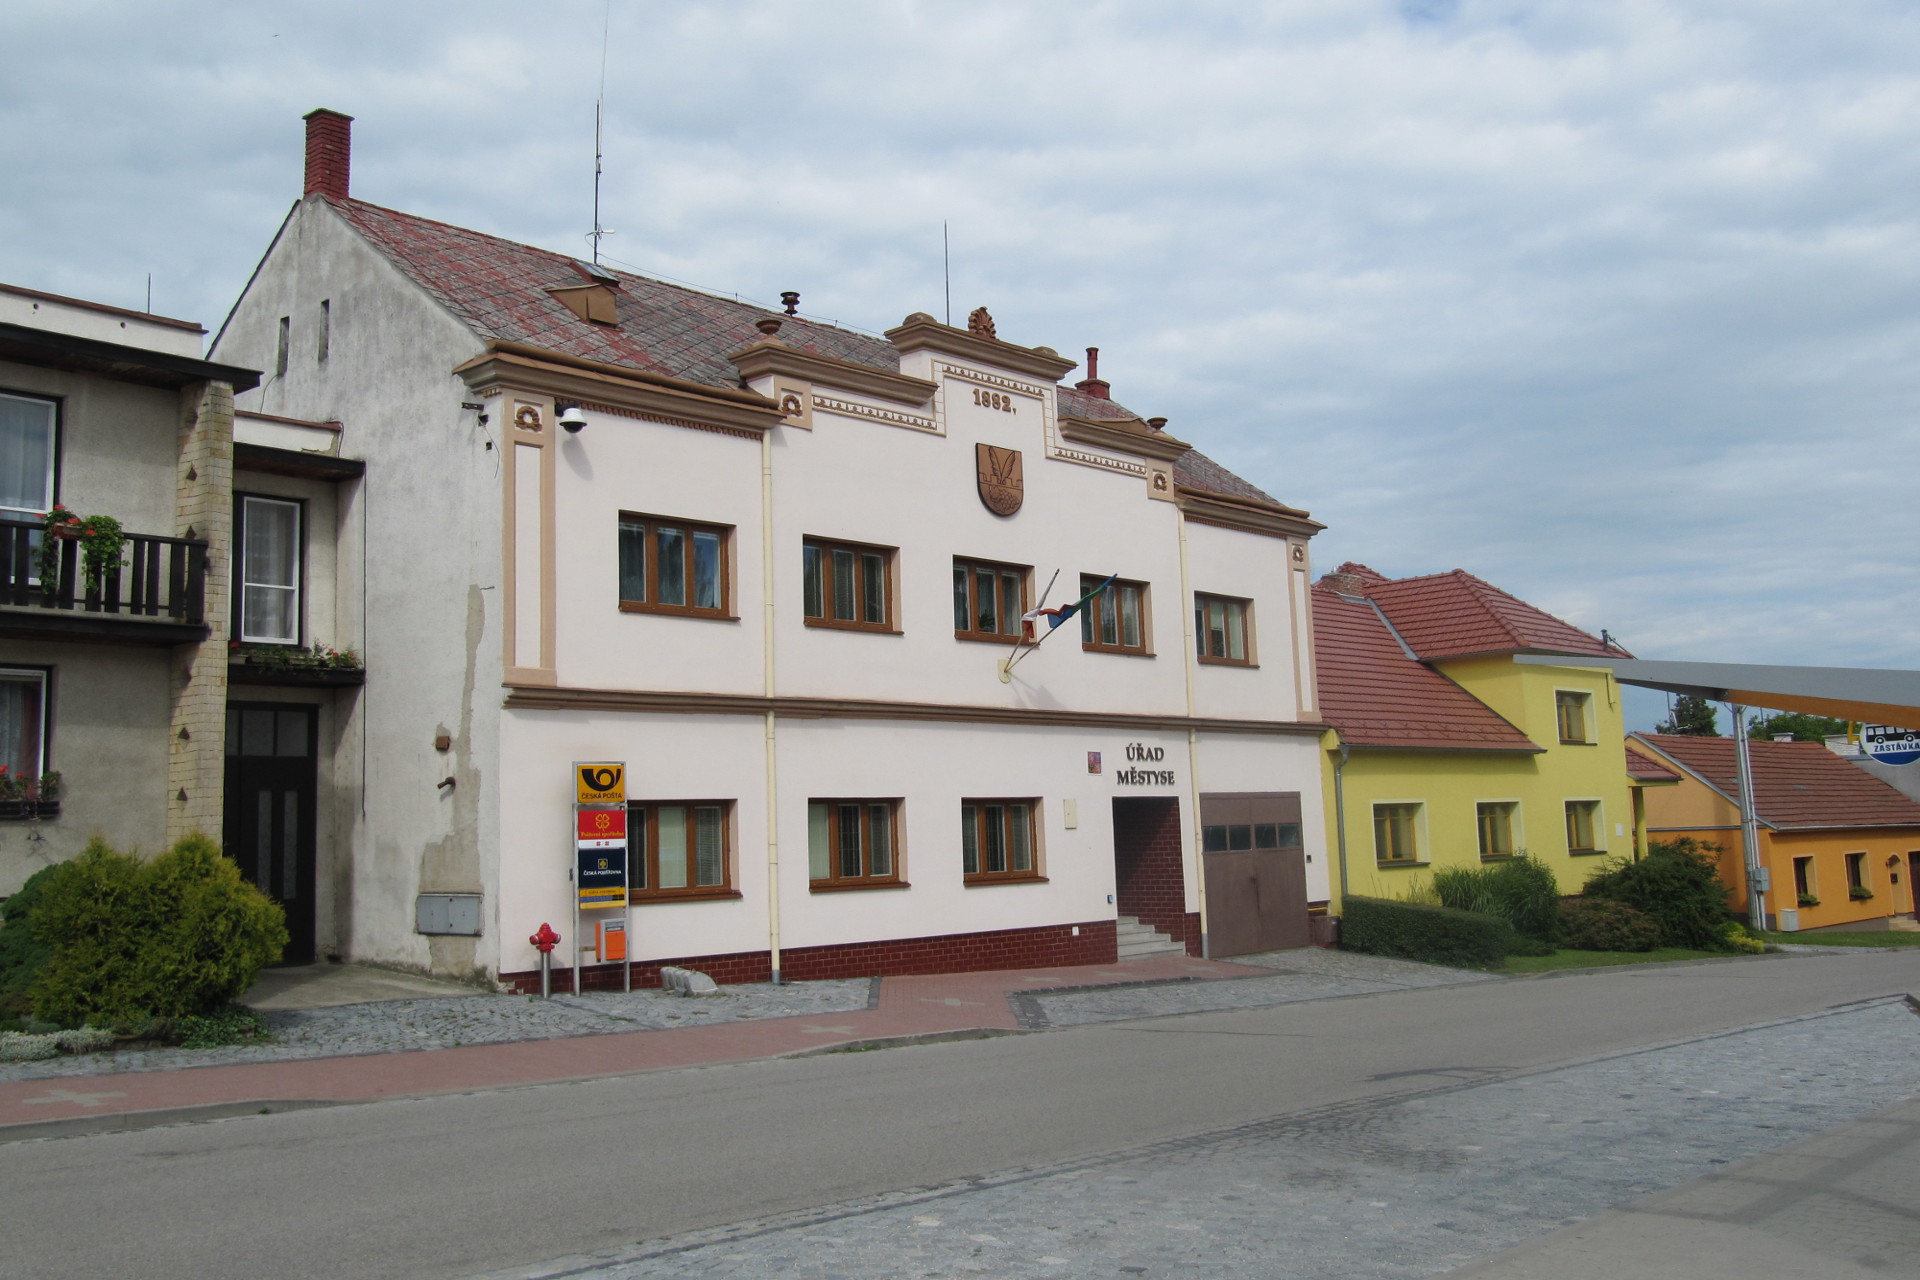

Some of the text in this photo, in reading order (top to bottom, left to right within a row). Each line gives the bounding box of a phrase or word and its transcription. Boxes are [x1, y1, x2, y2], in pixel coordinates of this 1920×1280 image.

[1125, 742, 1164, 761] ÚŘAD
[1874, 742, 1920, 752] ZASTÁVKA
[1117, 766, 1175, 785] MĚSTYSE
